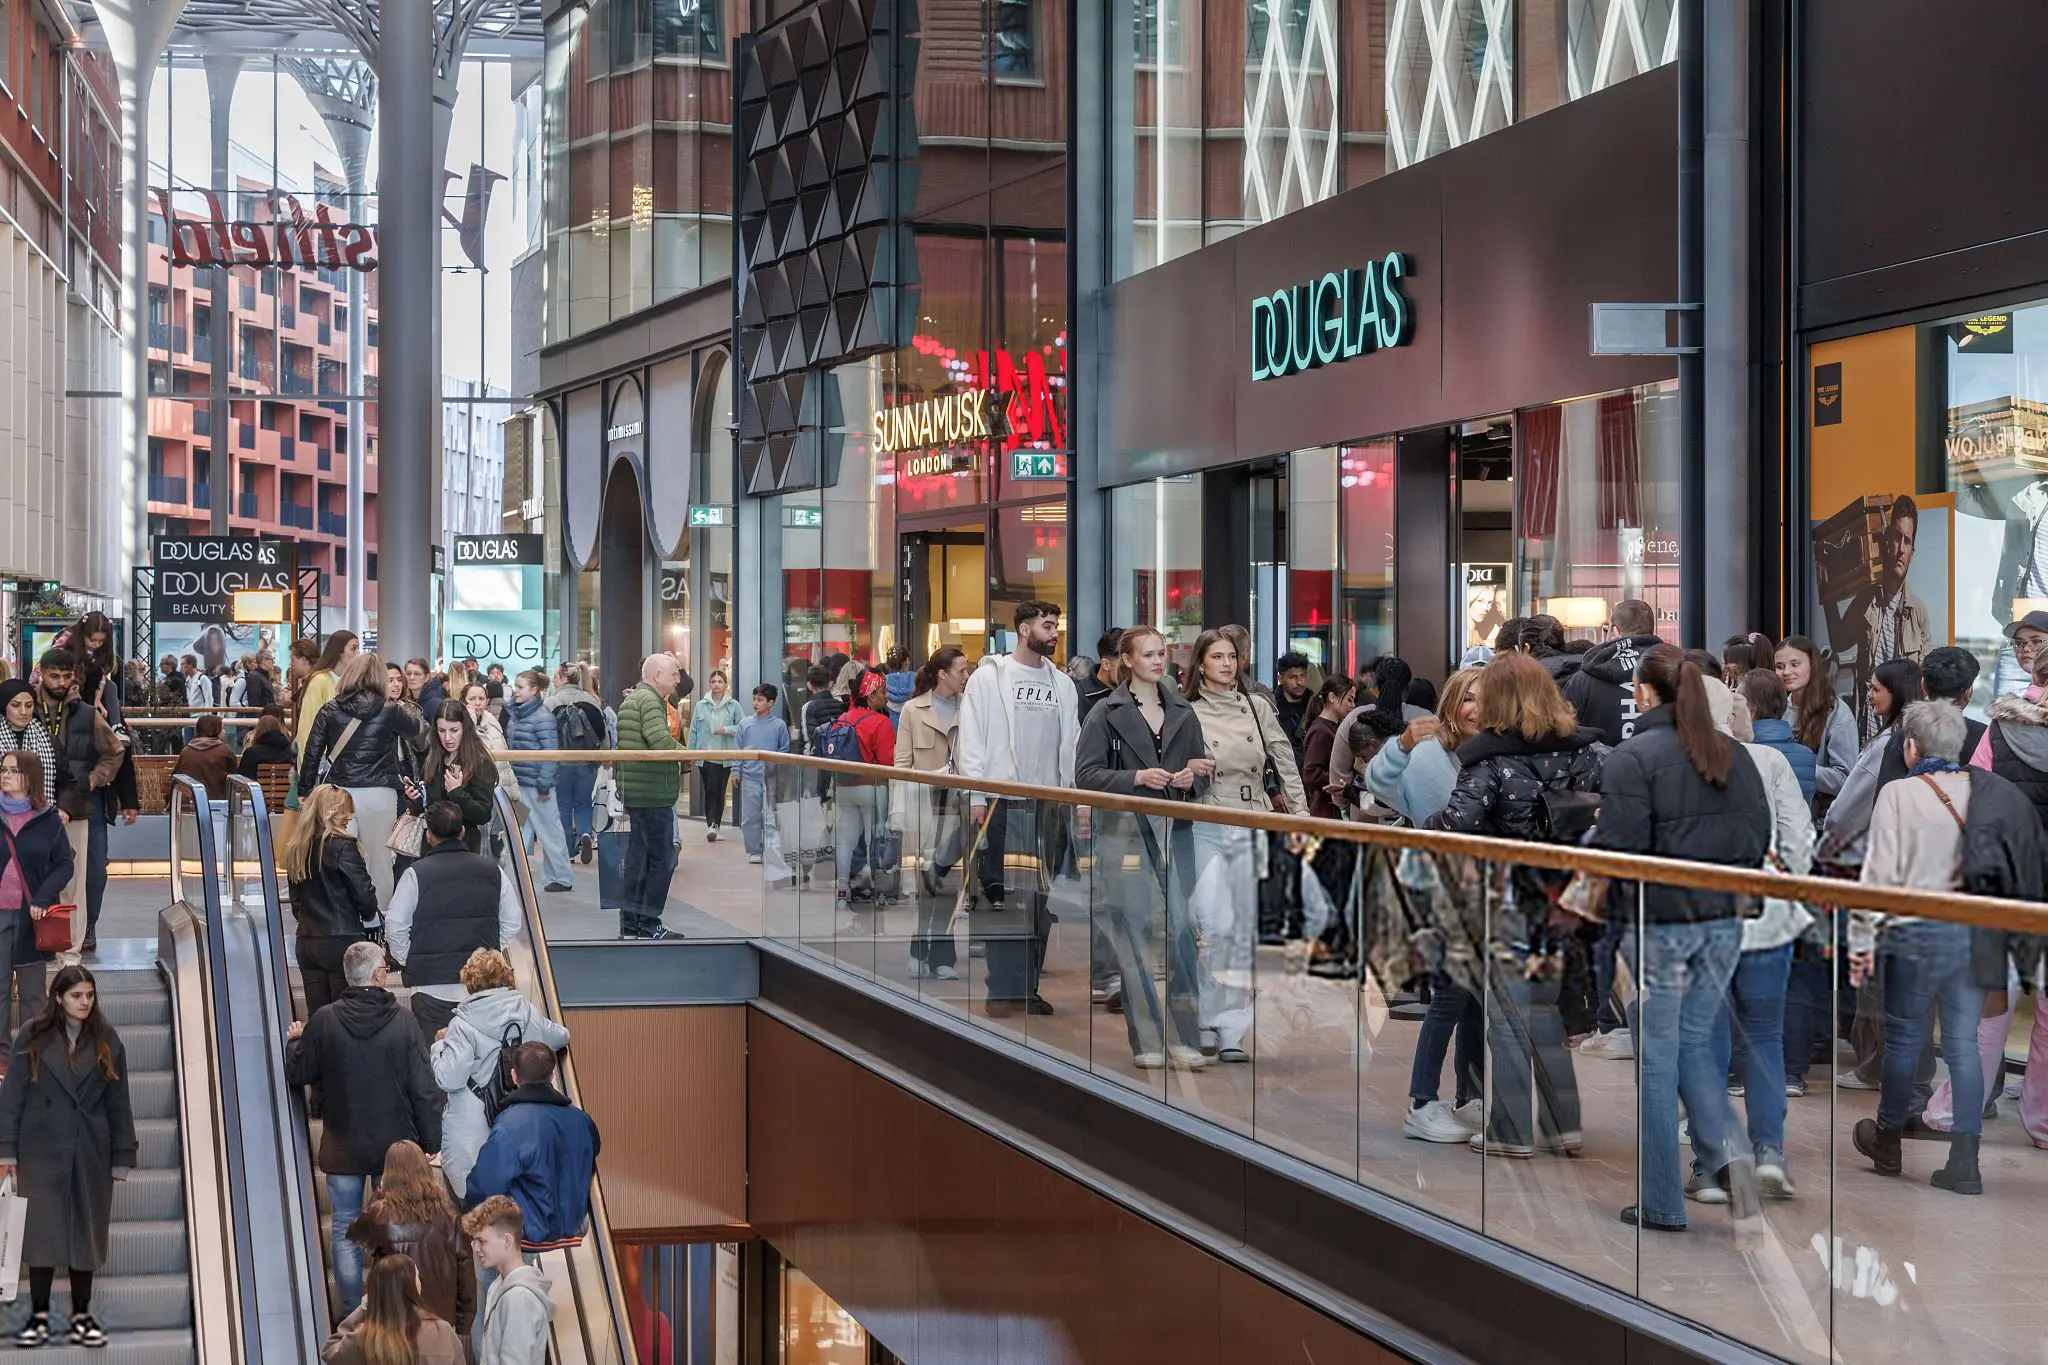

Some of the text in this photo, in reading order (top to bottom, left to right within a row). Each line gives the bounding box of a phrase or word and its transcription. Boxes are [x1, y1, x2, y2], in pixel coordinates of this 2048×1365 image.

[1252, 251, 1405, 382] DOUGLAS
[871, 389, 989, 453] SUNNAMUSK
[907, 454, 947, 477] LONDON
[160, 541, 253, 560] DOUGLAS
[457, 540, 518, 560] DOUGLAS
[173, 603, 227, 614] BEAUTY
[1012, 686, 1058, 703] EPLA
